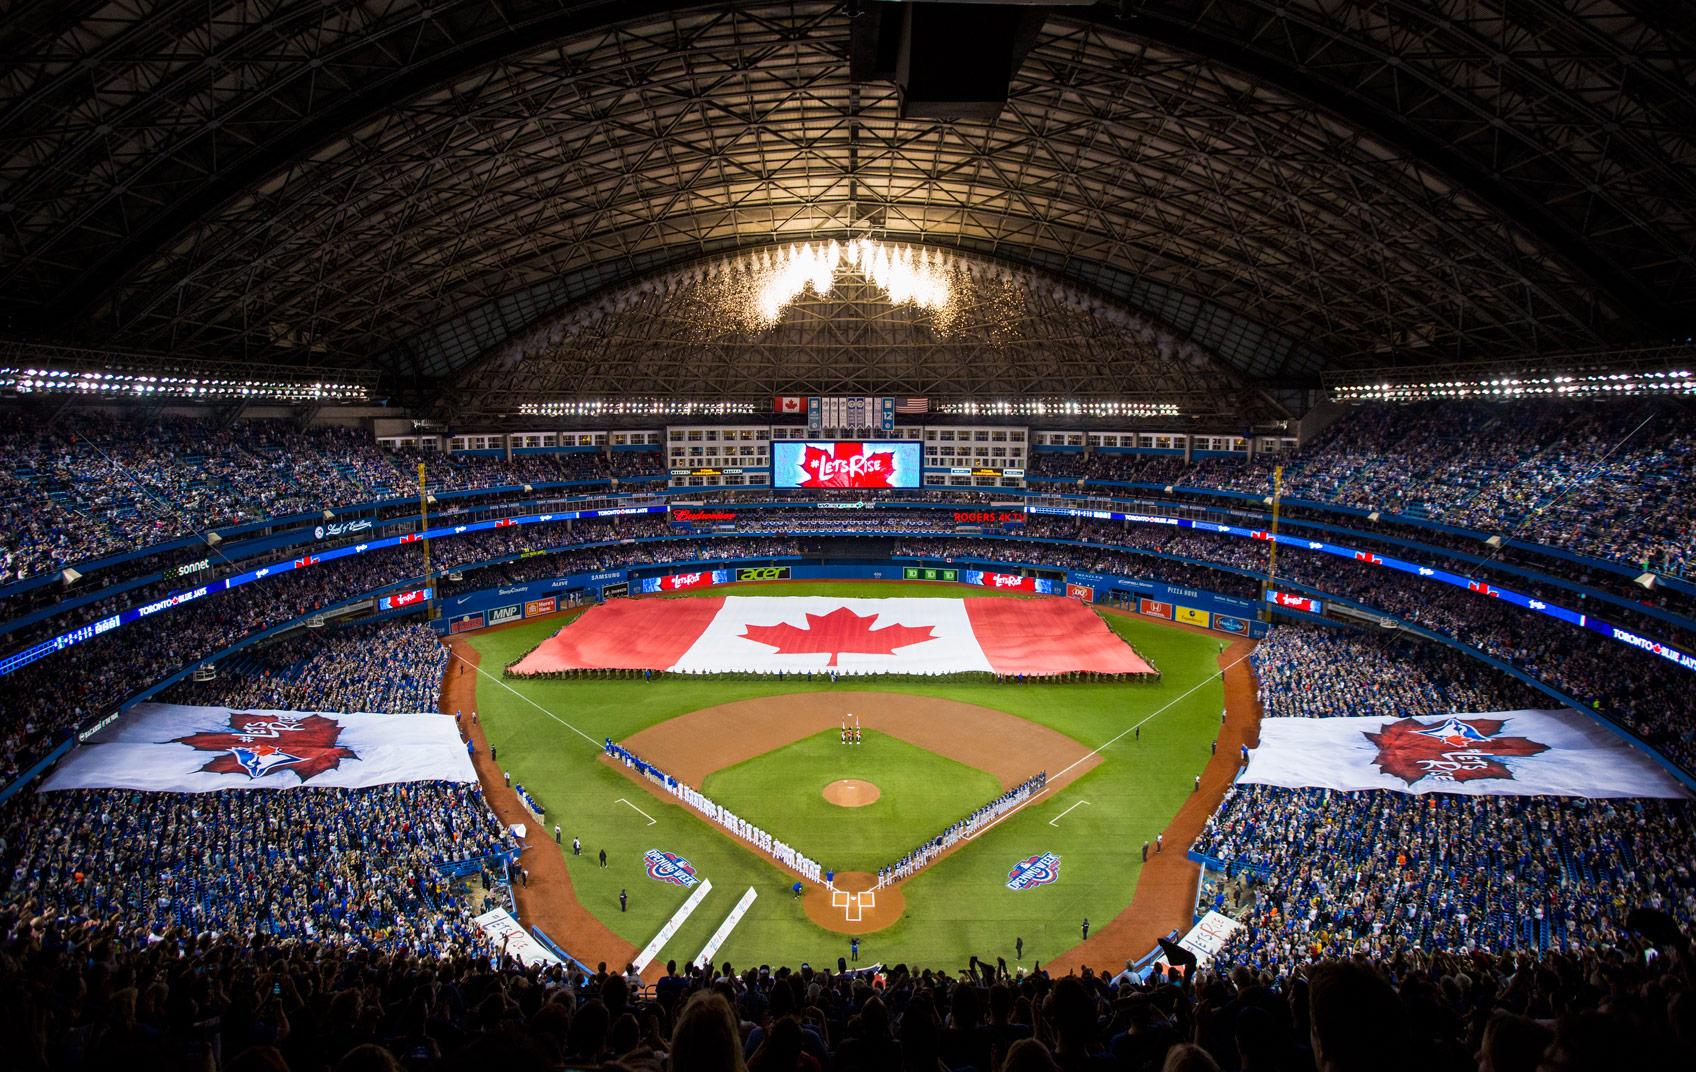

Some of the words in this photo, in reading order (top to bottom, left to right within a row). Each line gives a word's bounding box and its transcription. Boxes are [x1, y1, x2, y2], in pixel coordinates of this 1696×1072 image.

[883, 411, 893, 420] 12
[673, 509, 736, 521] Budweiser
[954, 512, 996, 522] ROGERS
[998, 513, 1011, 522] 4K
[1010, 513, 1026, 522] TV
[1125, 514, 1150, 522] TORONTO
[178, 558, 210, 576] sonnet
[908, 569, 917, 577] TD
[591, 571, 621, 581] SAMSUNG
[740, 567, 786, 581] acer
[926, 570, 936, 578] TD
[944, 571, 954, 579] TD
[1075, 588, 1086, 597] DQ
[1167, 586, 1184, 596] PIZZA
[1183, 590, 1198, 598] NOVA
[138, 599, 173, 617] TORONTO
[177, 591, 194, 604] BLUE
[193, 586, 207, 599] JAYS
[493, 606, 517, 620] MNP
[1613, 628, 1653, 651] TORONTO
[1660, 646, 1680, 663] BLUE
[646, 849, 679, 873] OPENING
[673, 869, 697, 888] WEEK
[1007, 865, 1043, 890] OPENING
[1034, 853, 1058, 869] WEEK
